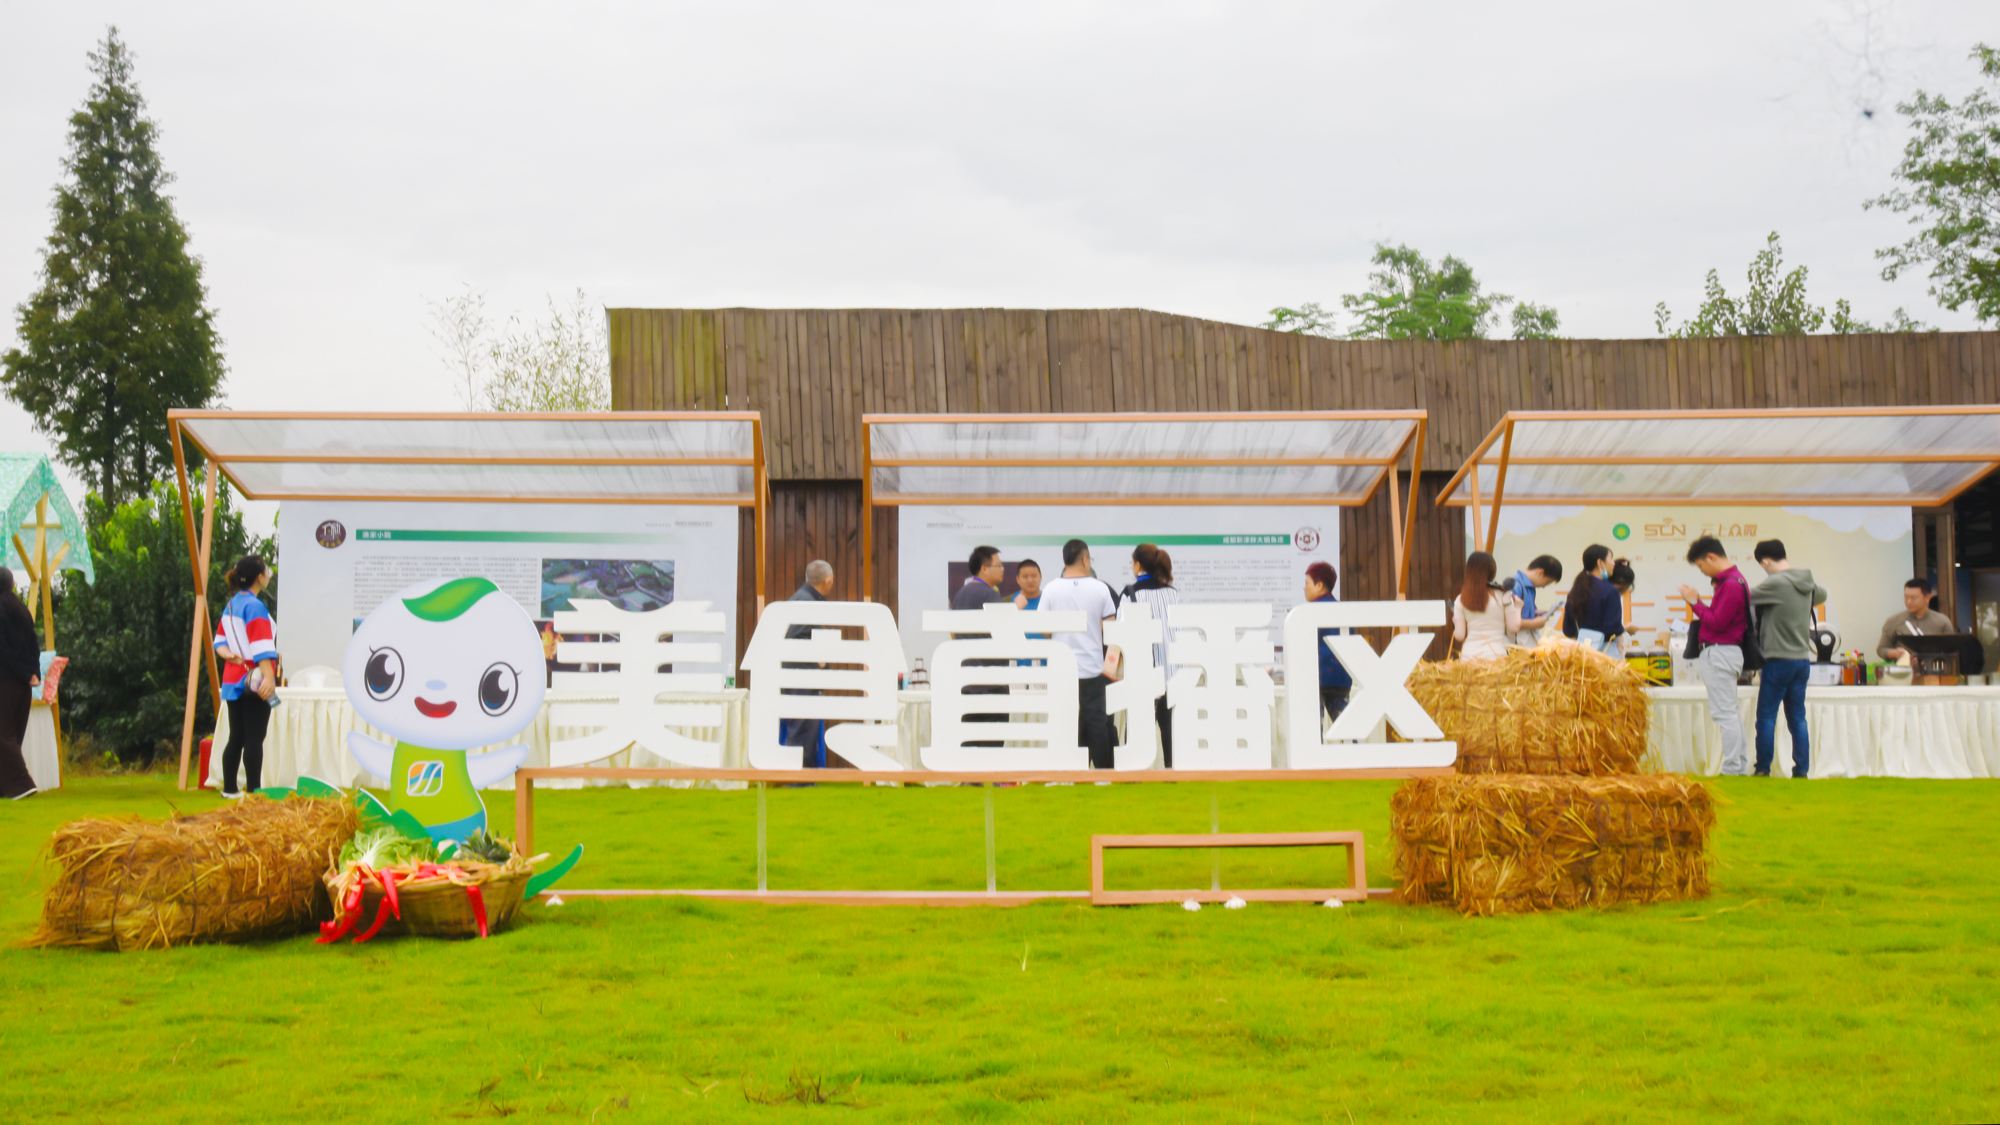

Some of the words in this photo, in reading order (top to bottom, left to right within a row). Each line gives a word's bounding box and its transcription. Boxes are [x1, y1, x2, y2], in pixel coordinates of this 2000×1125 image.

[550, 598, 1458, 772] 美食直播区
